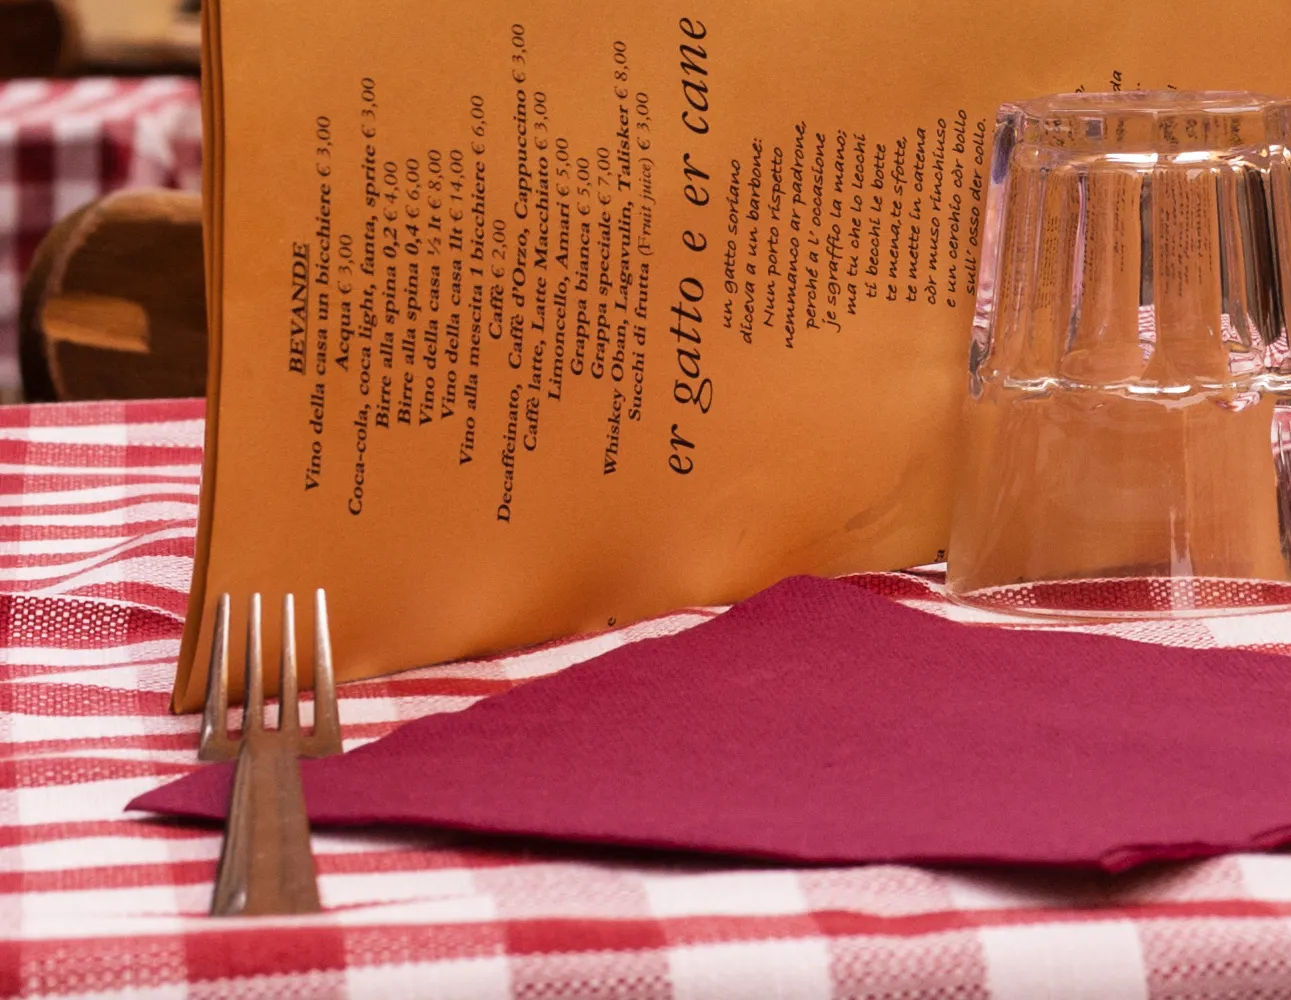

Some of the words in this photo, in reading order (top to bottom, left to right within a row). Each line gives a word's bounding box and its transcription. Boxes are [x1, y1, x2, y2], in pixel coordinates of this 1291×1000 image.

[511, 23, 527, 65] 3,00
[614, 40, 629, 82] 8,00
[361, 77, 378, 119] 3,00
[512, 69, 526, 84] €
[614, 86, 628, 100] €
[678, 17, 710, 135] cane
[361, 125, 376, 139] €
[471, 95, 486, 137] 6,00
[534, 91, 549, 131] 3,00
[635, 91, 651, 131] 3,00
[951, 109, 967, 154] bollo
[316, 115, 332, 157] 3,00
[470, 140, 485, 156] €
[513, 89, 533, 220] Cappuccino
[534, 136, 548, 151] €
[555, 137, 571, 177] 5,00
[616, 104, 631, 192] Talisker
[637, 136, 650, 151] €
[913, 127, 927, 193] catena
[972, 118, 986, 165] collo.
[316, 162, 331, 178] €
[361, 144, 381, 208] sprite
[383, 161, 399, 204] 4,00
[406, 158, 421, 201] 6,00
[427, 149, 443, 192] 8,00
[449, 149, 465, 201] 14,00
[576, 157, 592, 196] 5,00
[597, 147, 612, 186] 7,00
[638, 157, 656, 203] juice)
[682, 152, 711, 207] er
[745, 137, 763, 222] barbone:
[767, 146, 786, 221] rispetto
[790, 120, 807, 206] padrone,
[834, 129, 848, 193] mano;
[851, 133, 866, 190] lecchi
[870, 143, 887, 190] botte
[890, 136, 908, 197] sfotte,
[929, 118, 947, 212] rinchiuso
[950, 158, 964, 189] còr
[969, 168, 983, 202] der
[383, 206, 398, 222] €
[405, 203, 420, 219] €
[427, 194, 442, 210] €
[448, 206, 463, 222] €
[470, 161, 486, 261] bicchiere
[533, 156, 549, 271] Macchiato
[556, 183, 570, 197] €
[576, 200, 591, 216] €
[598, 192, 611, 206] €
[725, 159, 741, 236] soriano
[829, 198, 843, 219] la
[850, 194, 863, 213] lo
[870, 195, 883, 213] le
[908, 197, 922, 221] in
[315, 183, 332, 286] bicchiere
[382, 226, 400, 259] 0,2
[404, 223, 423, 256] 0,4
[427, 215, 442, 231] lt
[491, 219, 507, 260] 2,00
[555, 201, 570, 270] Amari
[638, 204, 653, 256] (Fruit
[681, 229, 708, 253] e
[748, 226, 758, 257] un
[790, 207, 801, 232] ar
[847, 217, 862, 249] che
[928, 216, 941, 271] muso
[948, 193, 962, 260] cerchio
[968, 205, 981, 247] osso
[338, 234, 354, 274] 3,00
[359, 215, 379, 277] fanta,
[511, 228, 530, 308] d'Orzo,
[574, 222, 591, 292] bianca
[597, 211, 613, 297] speciale
[614, 200, 634, 312] Lagavulin,
[723, 239, 738, 294] gatto
[745, 262, 757, 276] a
[767, 226, 782, 276] porto
[808, 250, 819, 264] a
[825, 223, 844, 306] sgraffio
[846, 255, 859, 277] tu
[865, 217, 881, 276] becchi
[907, 224, 921, 280] mette
[338, 281, 352, 295] €
[382, 265, 401, 325] spina
[403, 263, 422, 321] spina
[429, 265, 441, 313] casa
[451, 259, 463, 307] casa
[469, 267, 484, 277] 1
[491, 264, 505, 279] €
[634, 263, 650, 320] frutta
[783, 237, 800, 349] nemmanco
[864, 282, 877, 298] ti
[885, 284, 898, 302] te
[905, 284, 918, 302] te
[923, 274, 937, 305] còr
[947, 264, 957, 293] un
[288, 241, 310, 376] BEVANDE
[318, 293, 329, 321] un
[358, 283, 378, 340] light,
[488, 284, 505, 340] Caffè
[531, 276, 547, 333] Latte
[723, 299, 733, 329] un
[739, 280, 755, 345] diceva
[763, 280, 775, 327] Nun
[804, 266, 820, 330] perché
[821, 310, 842, 334] je
[847, 282, 857, 316] ma
[946, 298, 956, 308] e
[334, 301, 356, 372] Acqua
[401, 328, 417, 366] alla
[422, 319, 439, 370] della
[444, 313, 461, 364] della
[468, 284, 483, 367] mescita
[507, 314, 525, 370] Caffè
[547, 276, 571, 402] Limoncello,
[570, 299, 591, 376] Grappa
[590, 303, 611, 380] Grappa
[633, 324, 647, 347] di
[669, 276, 713, 415] gatto
[316, 328, 328, 377] casa
[359, 346, 372, 396] coca
[379, 331, 395, 369] alla
[527, 339, 547, 391] latte,
[610, 319, 630, 383] Oban,
[308, 383, 326, 435] della
[375, 375, 392, 429] Birre
[396, 371, 414, 426] Birre
[418, 376, 435, 426] Vino
[440, 369, 457, 420] Vino
[463, 373, 479, 411] alla
[627, 351, 645, 422] Succhi
[459, 416, 476, 466] Vino
[523, 396, 540, 452] Caffè
[603, 388, 626, 476] Whiskey
[304, 440, 322, 491] Vino
[348, 403, 372, 516] Coca-cola,
[496, 383, 523, 524] Decaffeinato,
[668, 423, 696, 475] er
